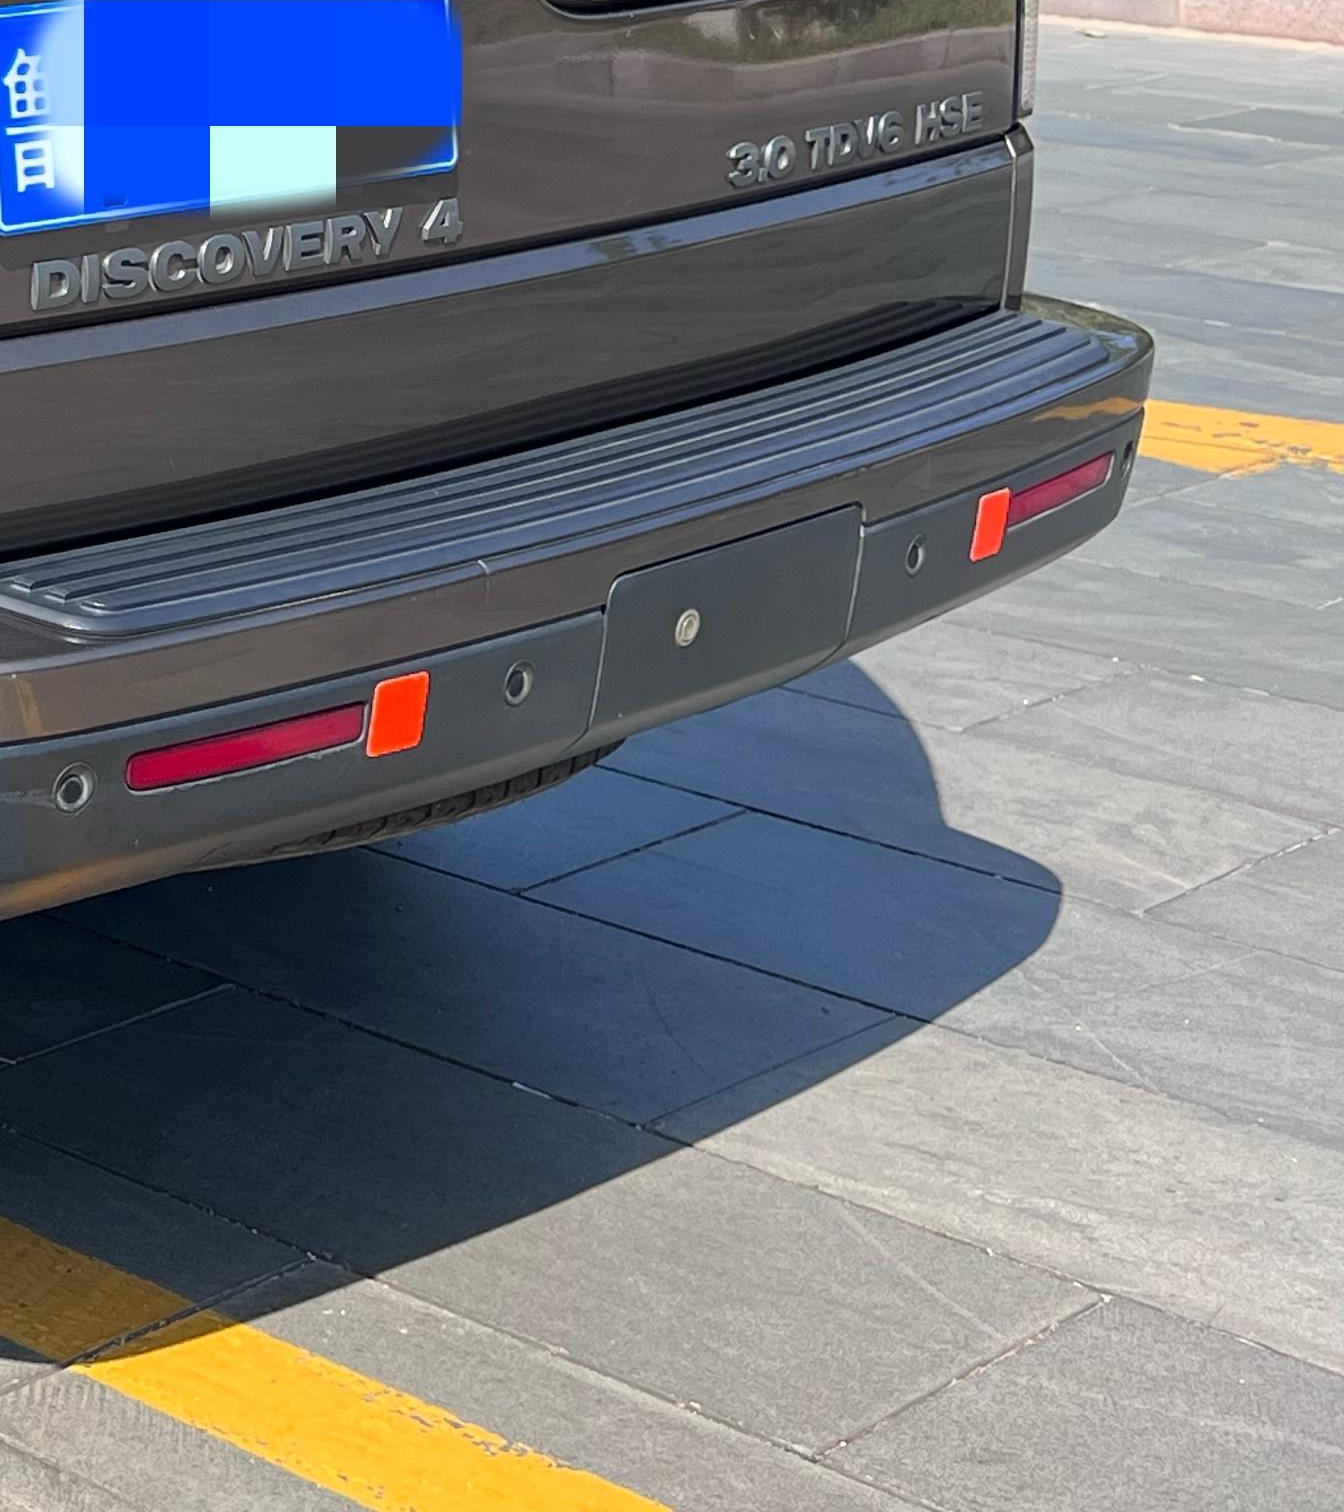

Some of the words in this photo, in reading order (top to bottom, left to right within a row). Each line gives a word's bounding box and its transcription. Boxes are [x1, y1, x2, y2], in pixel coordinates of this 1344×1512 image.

[726, 135, 797, 187] 3.0
[805, 110, 904, 170] TDV6
[915, 91, 983, 144] HSE
[31, 207, 403, 311] DISCOVERY
[421, 197, 463, 245] 4
